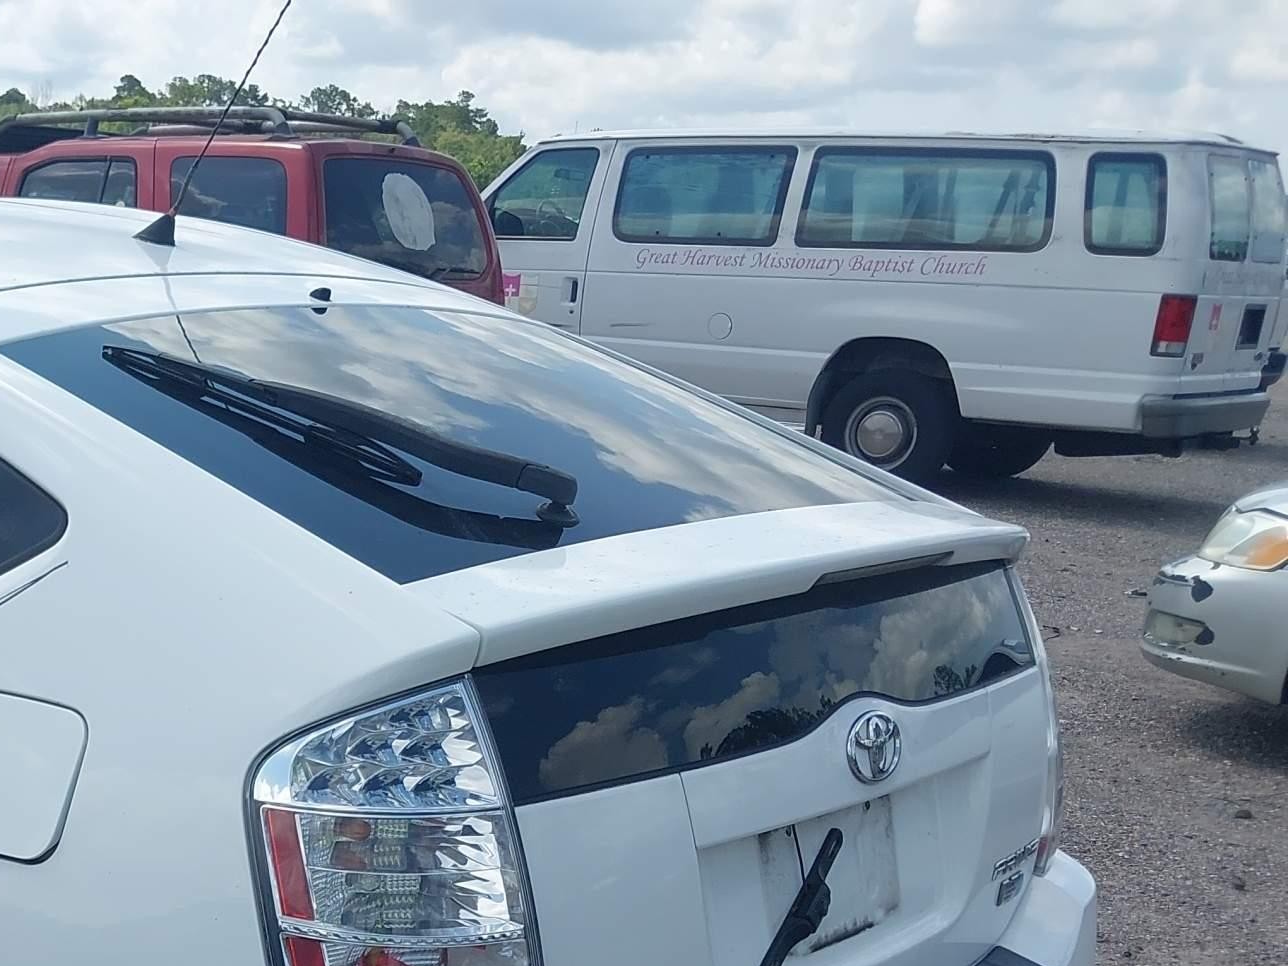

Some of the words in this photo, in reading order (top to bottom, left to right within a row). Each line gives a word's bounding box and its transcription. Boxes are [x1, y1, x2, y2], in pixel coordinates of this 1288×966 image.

[636, 248, 678, 269] Great
[680, 249, 746, 266] Harvest
[750, 252, 844, 276] Missionary
[848, 255, 914, 277] Baptist
[920, 255, 988, 276] Church
